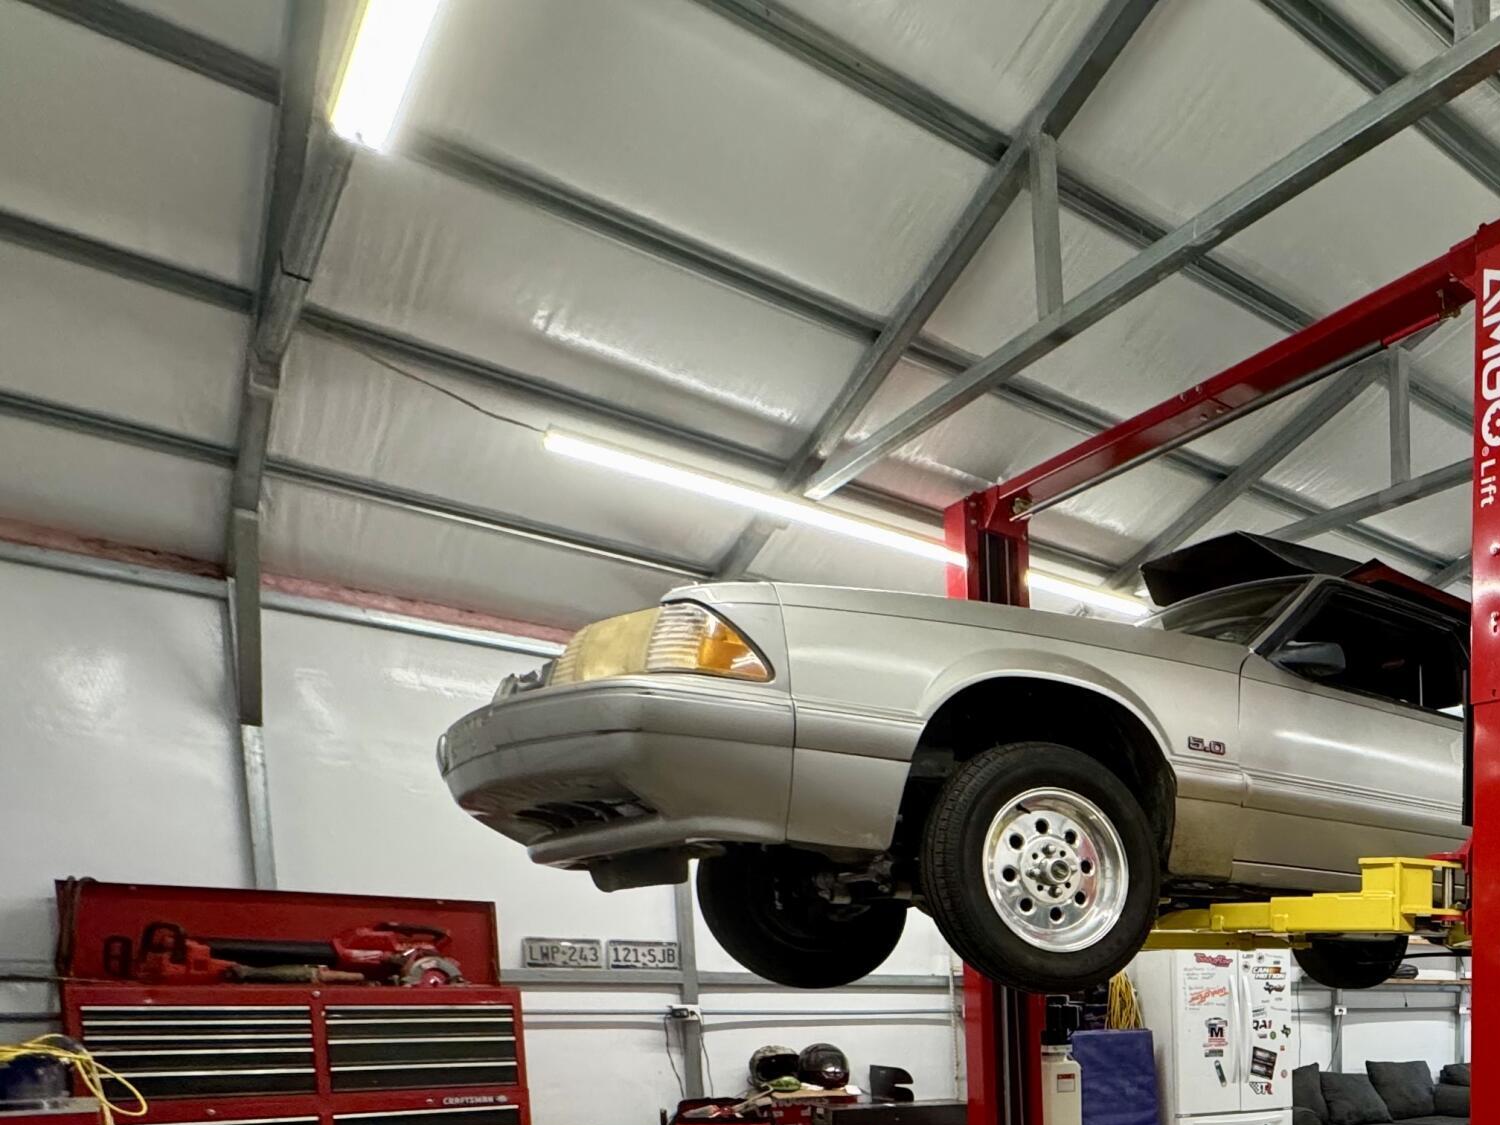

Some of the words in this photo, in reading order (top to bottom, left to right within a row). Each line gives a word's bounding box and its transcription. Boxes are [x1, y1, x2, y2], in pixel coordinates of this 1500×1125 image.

[1480, 461, 1495, 508] Lift
[1188, 736, 1226, 755] 5.0
[443, 1095, 494, 1105] CRAFTSMAN
